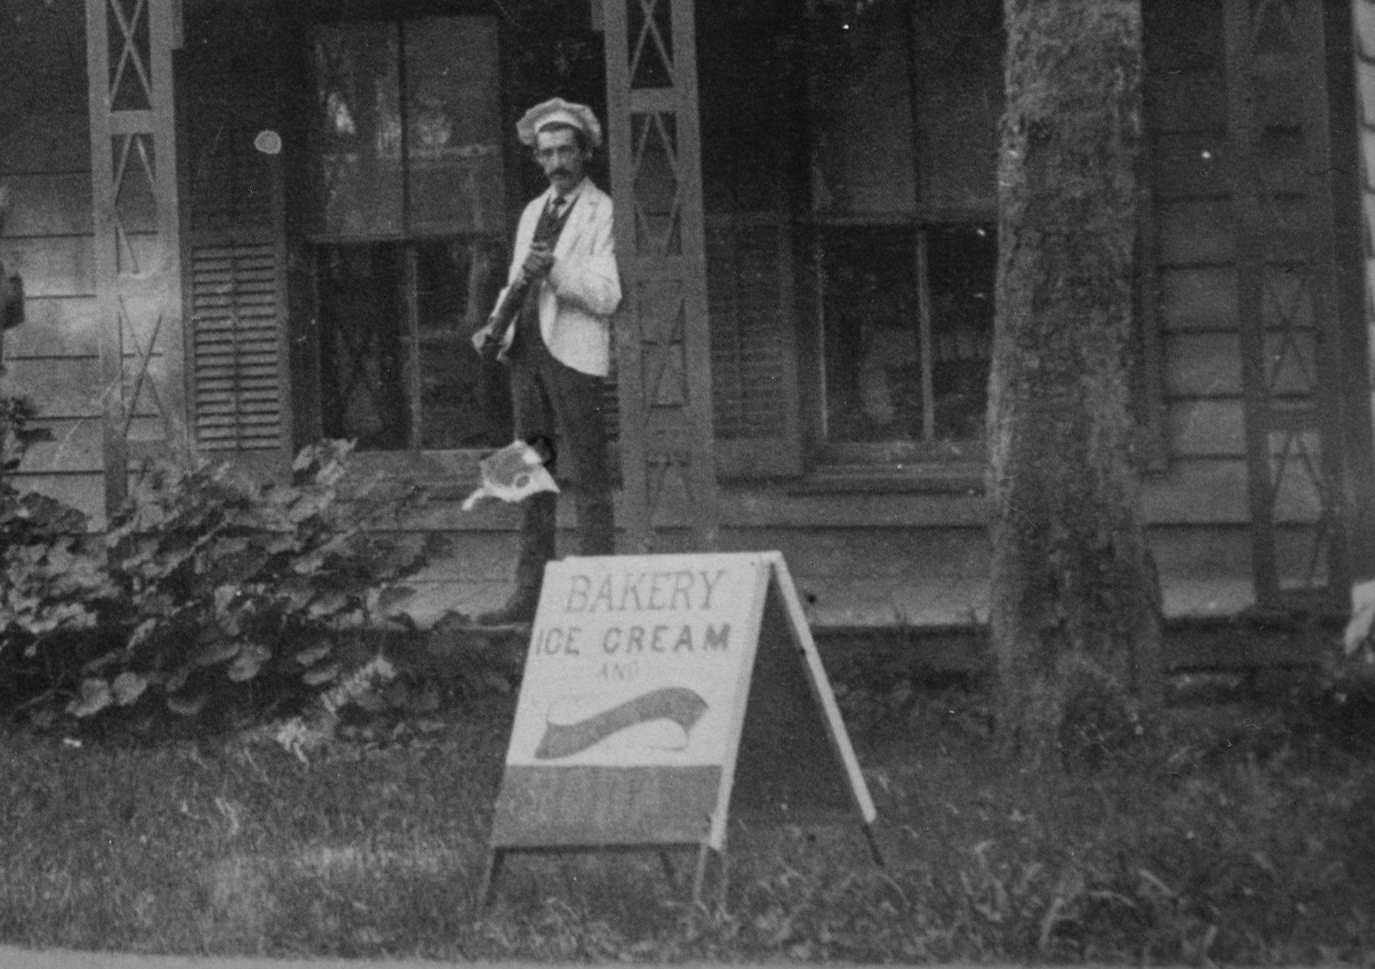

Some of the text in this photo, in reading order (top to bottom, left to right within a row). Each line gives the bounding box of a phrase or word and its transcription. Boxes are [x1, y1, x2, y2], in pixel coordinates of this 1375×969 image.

[564, 569, 726, 614] BAKERY
[535, 622, 731, 657] ICE CREAM
